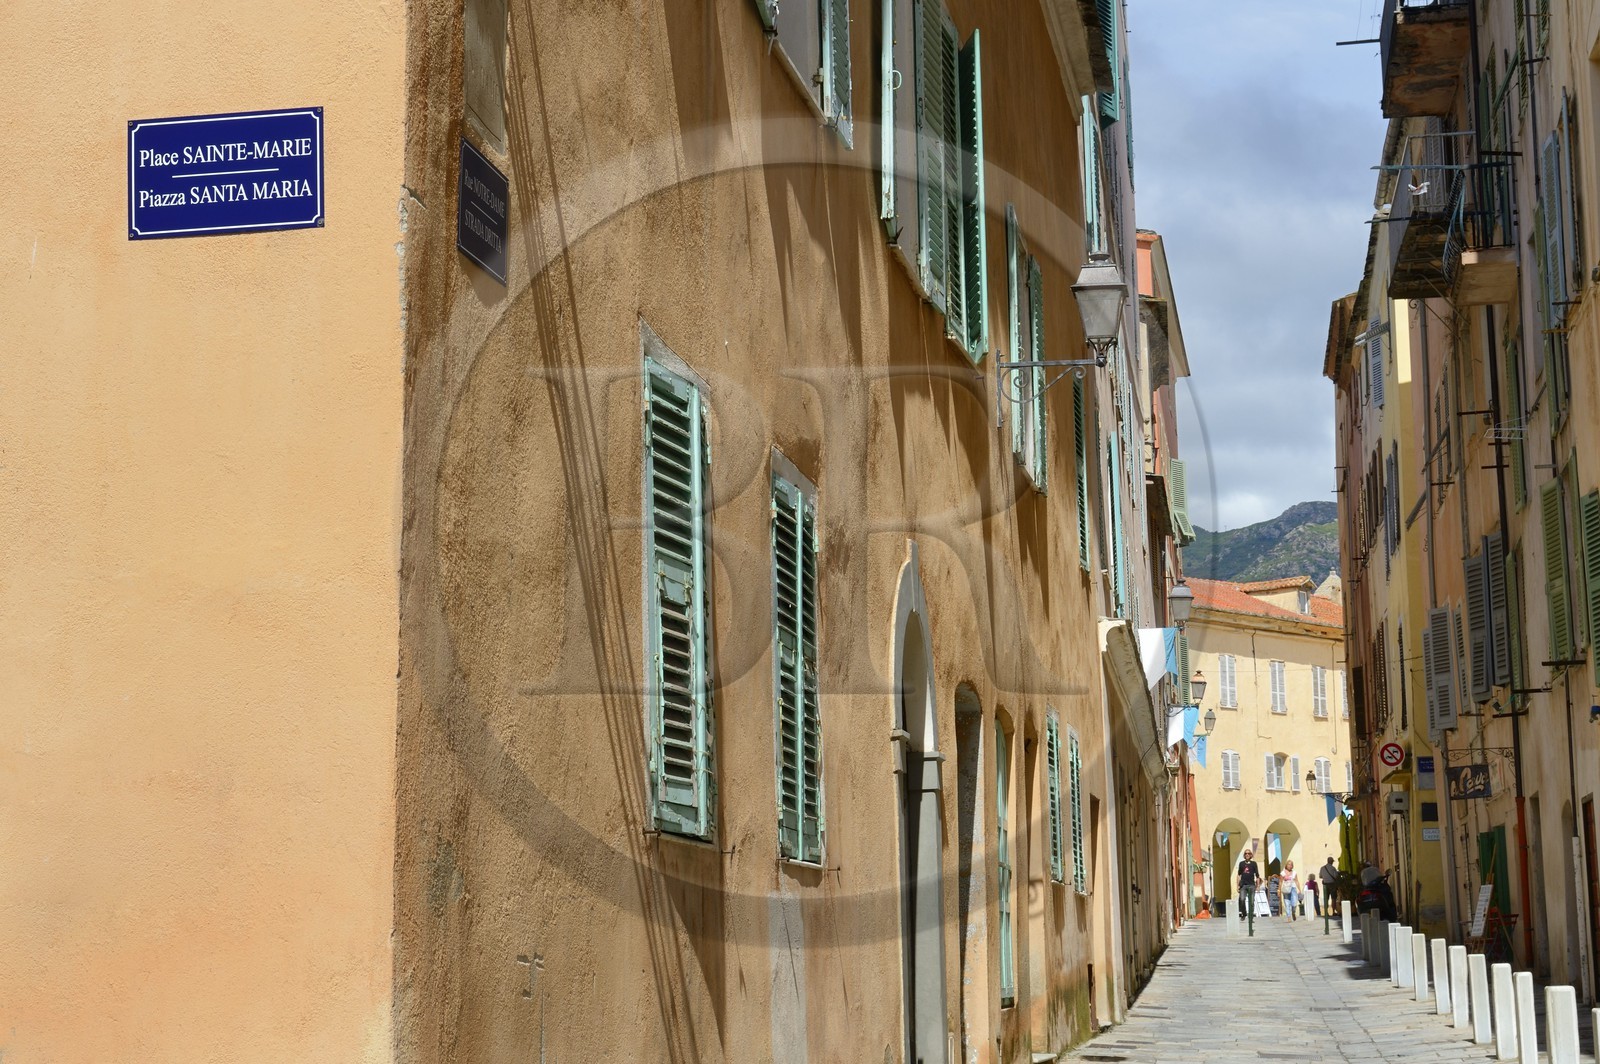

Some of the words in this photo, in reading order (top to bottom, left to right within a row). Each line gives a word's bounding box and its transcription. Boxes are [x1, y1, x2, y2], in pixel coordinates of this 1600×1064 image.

[139, 149, 179, 168] Place
[183, 138, 312, 165] SAINTE-MARIE
[139, 190, 186, 208] Piazza
[190, 183, 248, 205] SANTA
[252, 179, 313, 201] MARIA
[464, 169, 473, 190] Rue
[473, 177, 505, 219] NOTRE-DAME
[464, 209, 484, 240] STRADA
